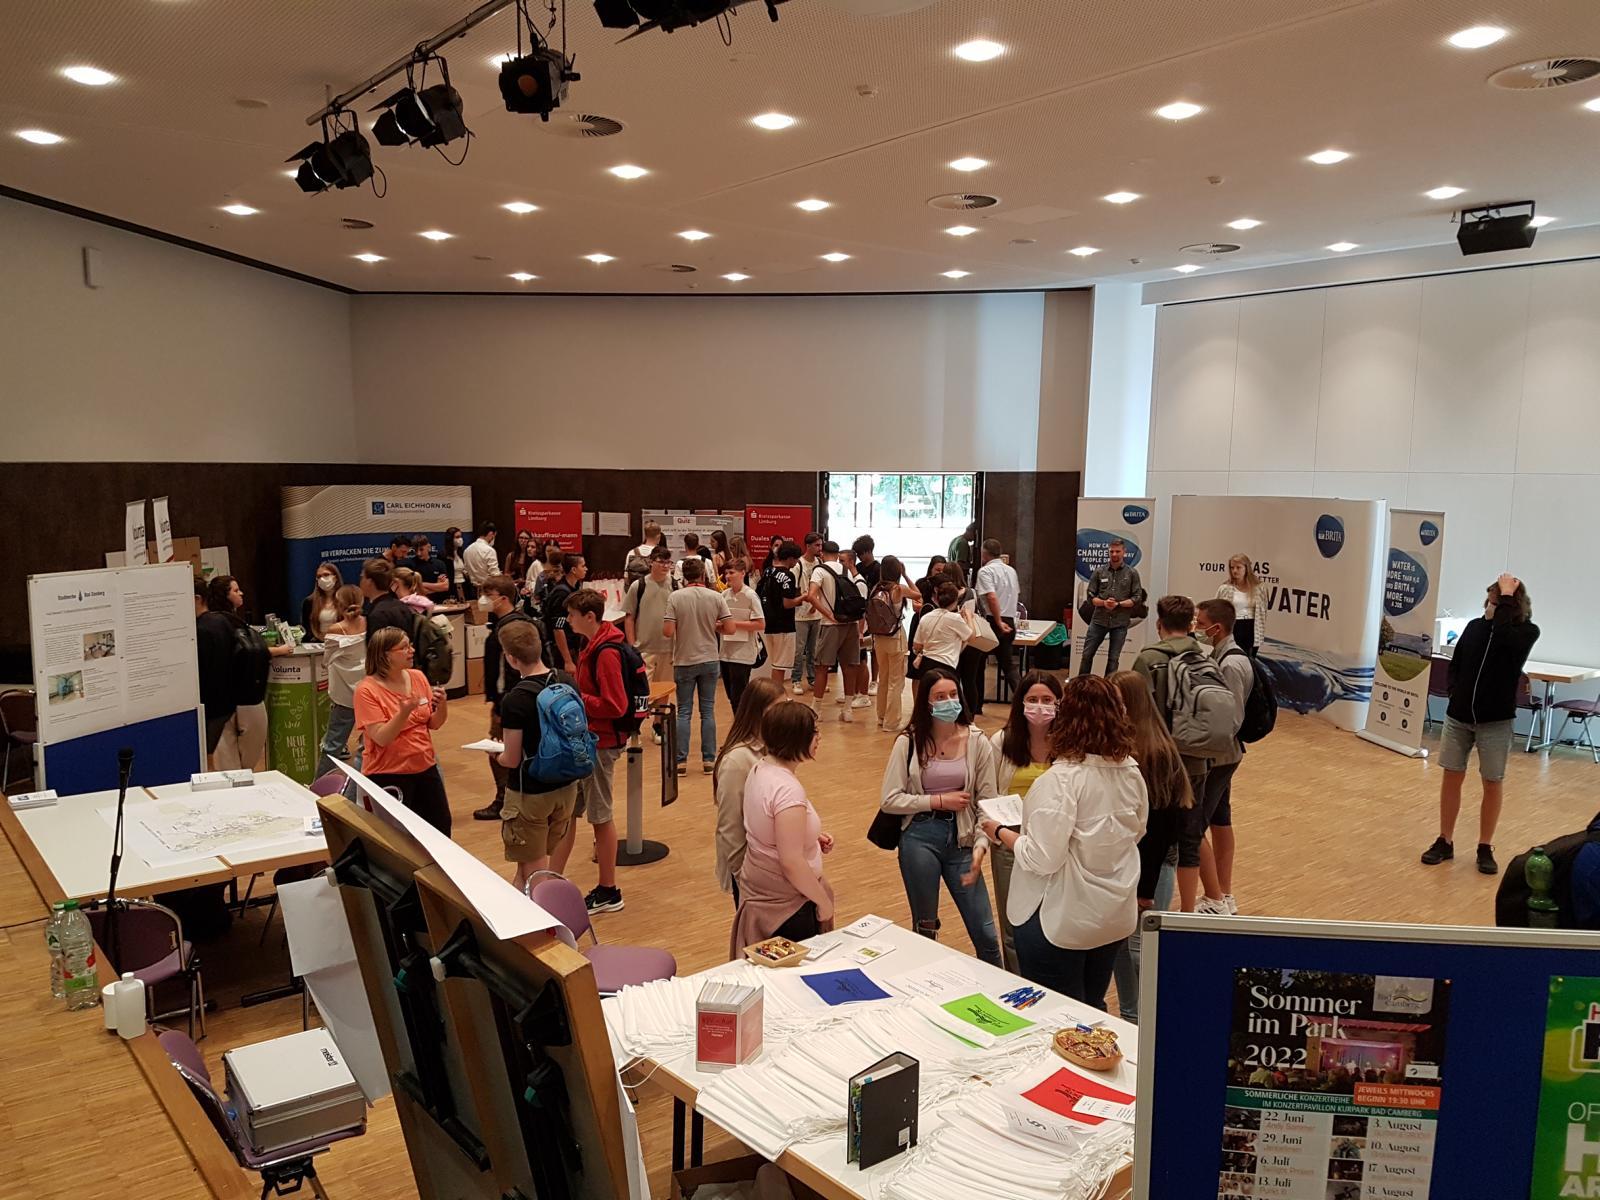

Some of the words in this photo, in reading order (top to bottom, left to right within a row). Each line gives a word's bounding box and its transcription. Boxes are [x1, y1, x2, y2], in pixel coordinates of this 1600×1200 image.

[1324, 530, 1342, 542] BRITA
[329, 548, 362, 557] VERPACKEN
[1078, 549, 1108, 557] CHANGE
[1200, 562, 1225, 572] YOUR
[1392, 560, 1411, 571] WATER
[1258, 576, 1280, 584] ETTER
[1386, 591, 1403, 602] MORE
[1250, 985, 1362, 1015] Sommer
[1248, 1012, 1280, 1034] im
[1290, 1014, 1347, 1039] Park
[1244, 1044, 1307, 1069] 2022
[1244, 1090, 1298, 1101] SOMMERLICHE
[1300, 1094, 1350, 1104] KONZERTREIHE
[1358, 1086, 1388, 1095] JEWEILS
[1390, 1088, 1435, 1098] MITTWOCHS
[1357, 1094, 1386, 1104] BEGINN
[1388, 1096, 1409, 1105] 19:30
[1410, 1097, 1426, 1106] UHR
[1262, 1100, 1271, 1108] IM
[1272, 1102, 1336, 1112] KONZERTPAVILLON
[1338, 1106, 1369, 1114] KURPARK
[1371, 1107, 1386, 1115] BAD
[1388, 1108, 1422, 1118] CAMBERG
[1568, 1102, 1600, 1121] OF
[1283, 1112, 1304, 1124] Juni
[1386, 1120, 1422, 1131] August
[1262, 1133, 1277, 1143] 29.
[1281, 1134, 1302, 1145] Juni
[1370, 1142, 1383, 1150] 10.
[1385, 1144, 1420, 1153] August
[1564, 1122, 1600, 1173] H
[1260, 1157, 1269, 1165] 6.
[1272, 1156, 1290, 1166] Juli
[1382, 1165, 1416, 1175] August
[1258, 1177, 1269, 1186] 13.
[1272, 1177, 1291, 1187] Juli
[1559, 1175, 1600, 1197] AR
[1380, 1188, 1414, 1197] August
